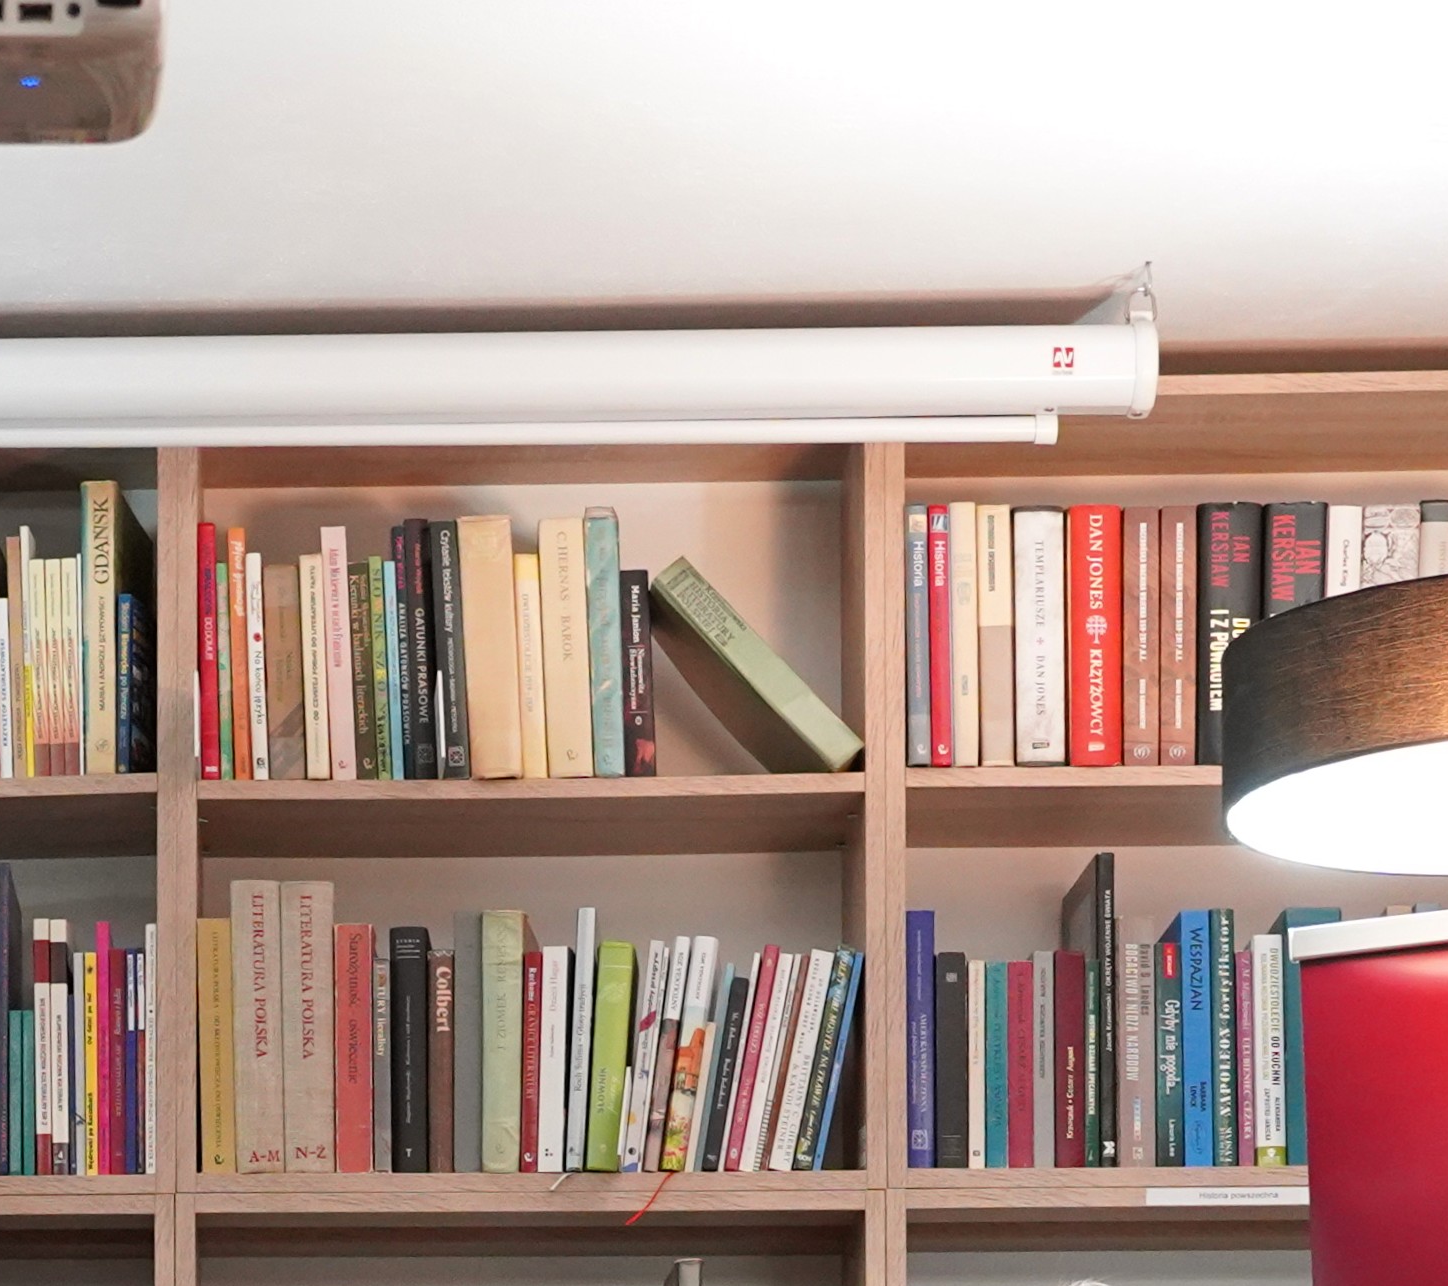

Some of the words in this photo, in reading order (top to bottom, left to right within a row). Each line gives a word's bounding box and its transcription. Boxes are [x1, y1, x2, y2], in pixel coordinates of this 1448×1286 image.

[93, 496, 109, 584] GDAŃSK
[1087, 513, 1103, 552] DAN
[1210, 511, 1231, 588] KERSHAW
[1232, 535, 1251, 563] IAN
[1296, 538, 1321, 576] IAN
[558, 546, 570, 601] HERNAS
[912, 540, 923, 588] Historia
[933, 539, 945, 587] Historia
[1271, 513, 1294, 602] KERSHAW
[631, 584, 640, 612] Maria
[1034, 539, 1045, 628] TEMPLARIUSZE
[1084, 555, 1104, 610] JONES
[414, 607, 425, 658] GATUNKI
[560, 615, 572, 662] BAROK
[631, 614, 641, 644] Janion
[1035, 655, 1046, 678] DAN
[416, 659, 429, 724] PRASOWE
[1036, 681, 1046, 717] JONES
[1086, 648, 1104, 737] KRZYŻOWCY
[251, 893, 266, 993] LITERATURA
[299, 894, 314, 993] LITERATURA
[435, 965, 452, 1033] Colbert
[253, 997, 268, 1059] POLSKA
[301, 998, 316, 1060] POLSKA
[1270, 1047, 1282, 1087] KUCHNI
[248, 1149, 281, 1164] A-M
[294, 1143, 327, 1160] N-Ż
[1198, 1191, 1228, 1200] Historia
[1230, 1191, 1279, 1202] powszechna
